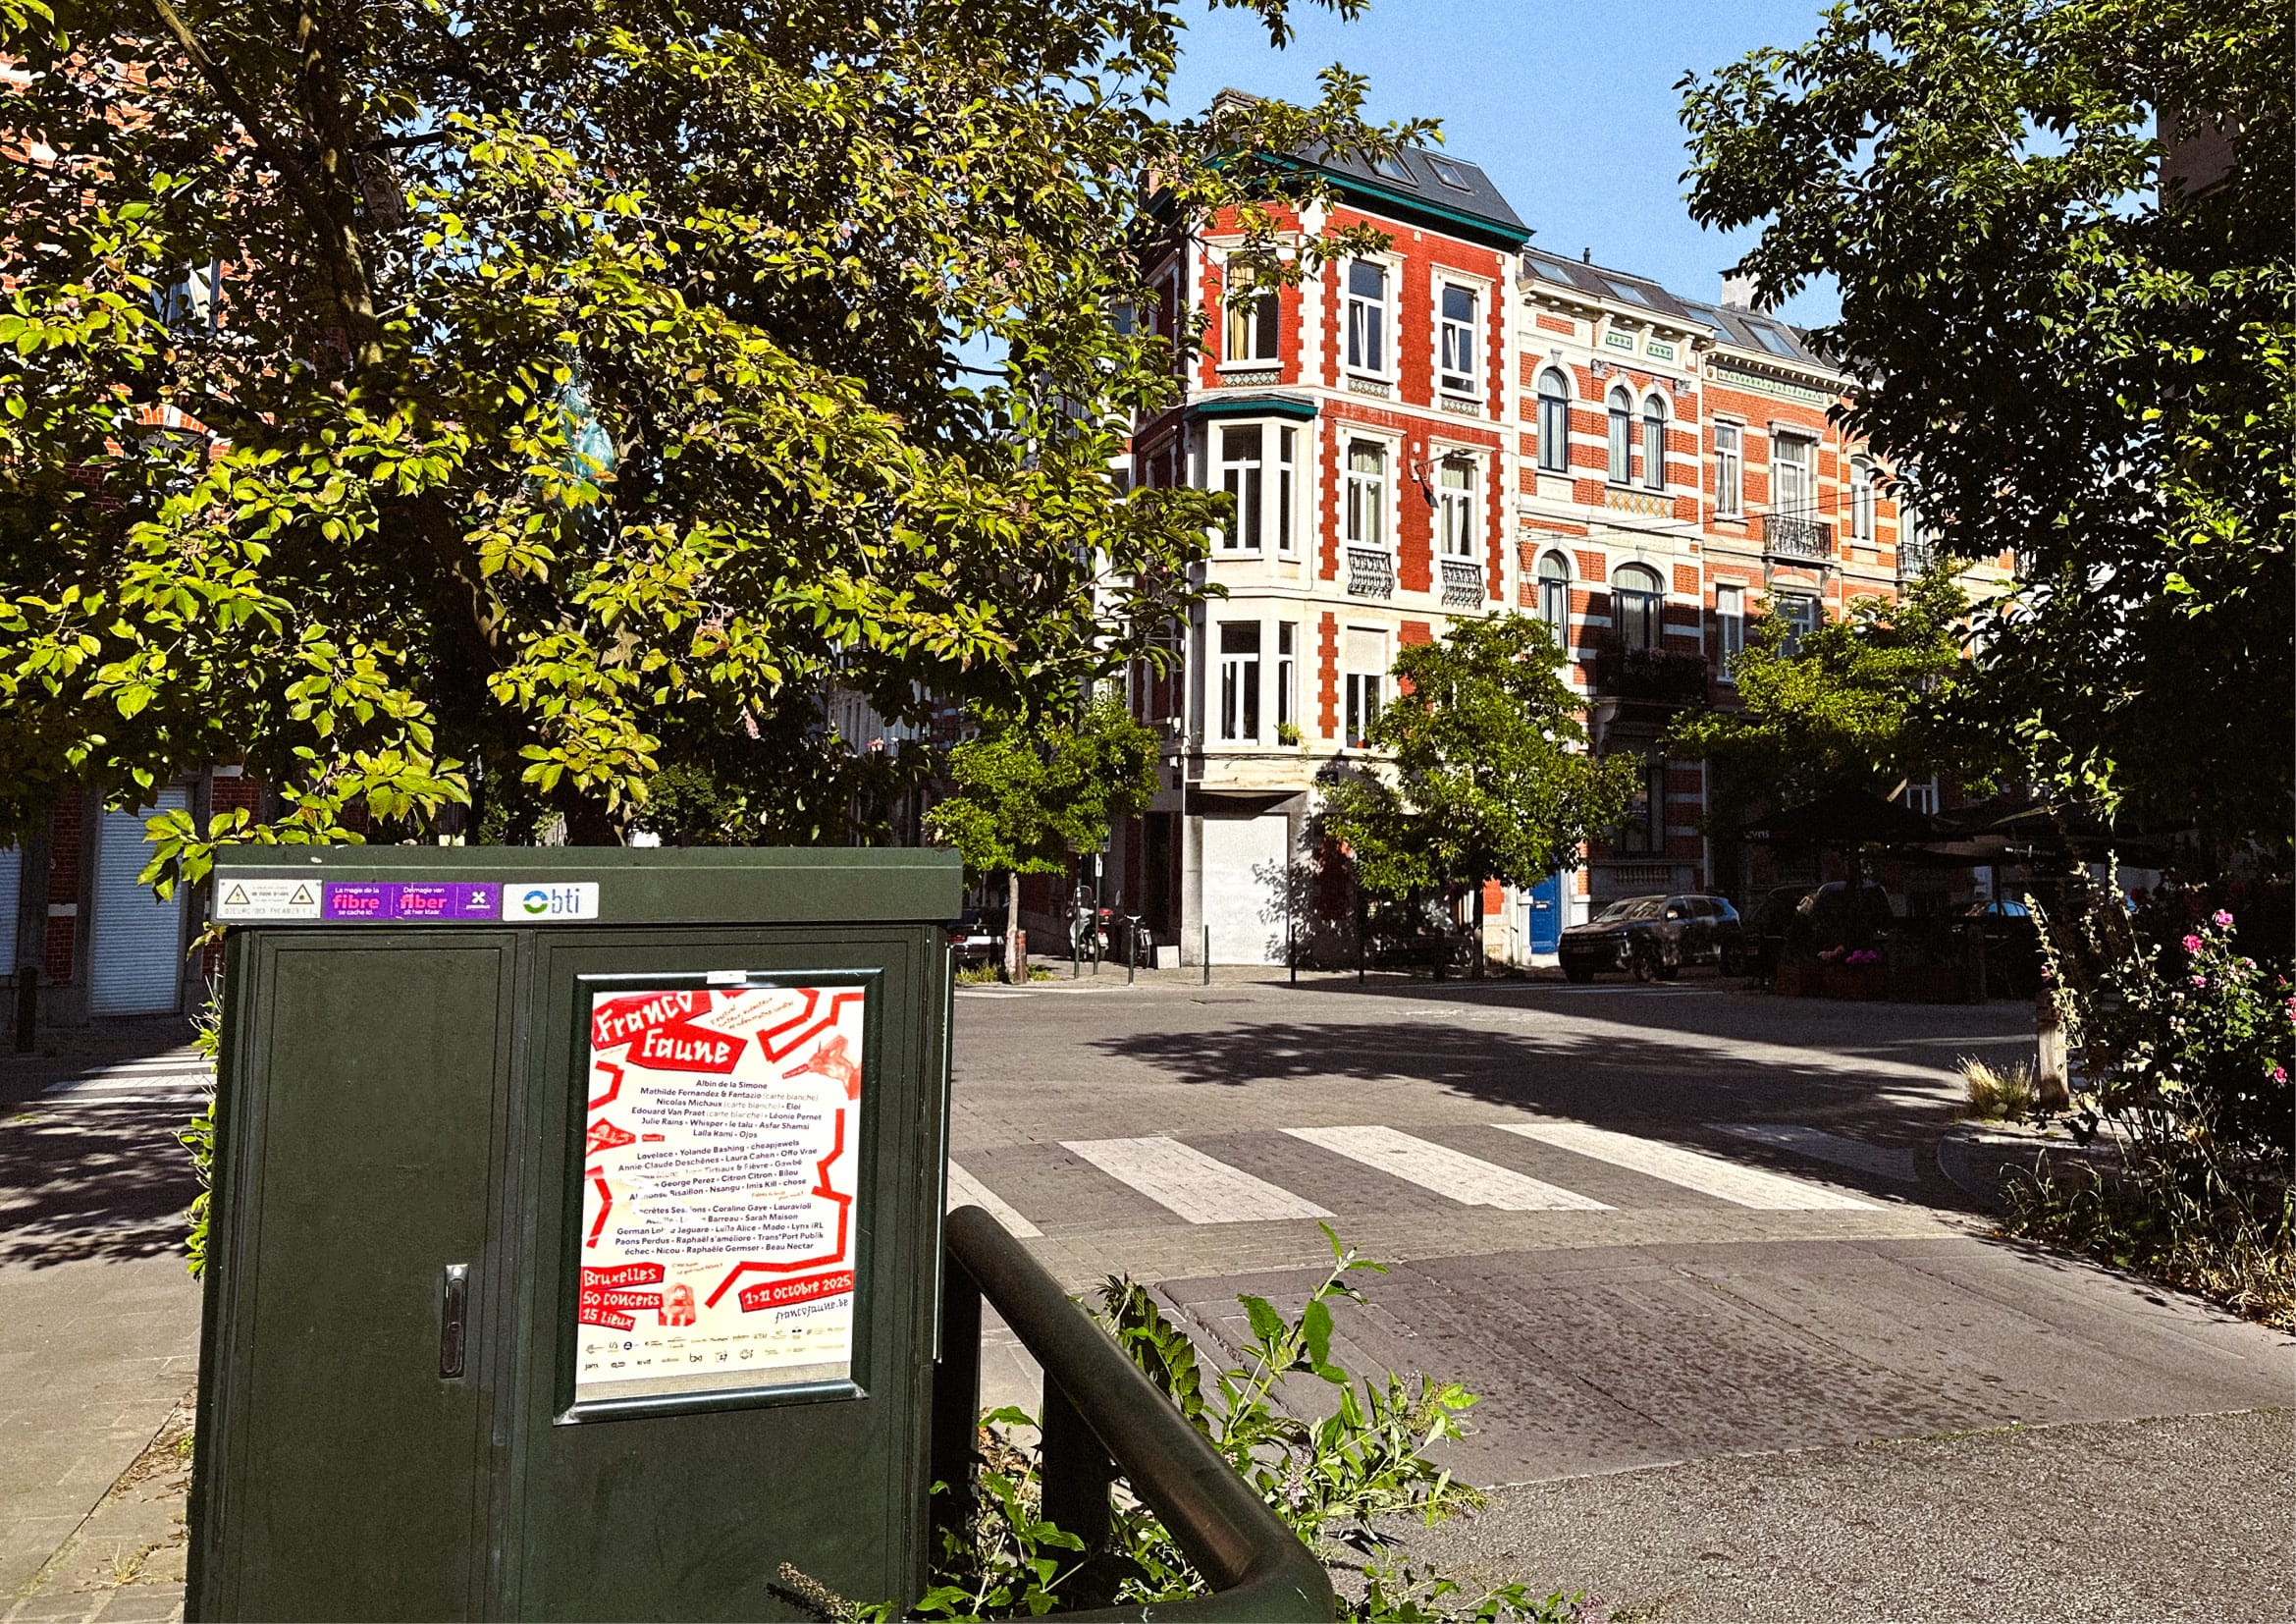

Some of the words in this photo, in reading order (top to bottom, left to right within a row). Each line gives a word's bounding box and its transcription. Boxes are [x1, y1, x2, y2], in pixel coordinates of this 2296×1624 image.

[333, 894, 380, 909] fibre
[400, 893, 448, 909] fiber
[552, 889, 580, 913] bti
[596, 991, 693, 1043] Franco
[642, 1027, 730, 1063] Faune
[640, 1087, 676, 1096] Mathilde
[677, 1089, 720, 1098] Fernandez
[656, 1098, 686, 1107] Nicolas
[688, 1099, 722, 1108] Michaux
[662, 1117, 683, 1126] Rains
[690, 1119, 723, 1128] Whisper
[739, 1130, 758, 1139] Ojos
[636, 1152, 673, 1161] Lovelace
[713, 1145, 745, 1154] Bashing
[751, 1140, 800, 1151] cheapjewels
[675, 1157, 720, 1166] Deschênes
[725, 1154, 748, 1163] Laura
[749, 1152, 775, 1161] Cahen
[661, 1179, 691, 1188] George
[747, 1204, 768, 1213] Gaye
[791, 1222, 810, 1231] Lynx
[675, 1235, 709, 1245] Raphaël
[624, 1247, 650, 1256] échec
[584, 1268, 656, 1286] Bruxelles
[822, 1273, 852, 1291] 2025
[583, 1290, 601, 1305] 50
[583, 1308, 598, 1321] 15
[774, 1298, 849, 1325] francofaune.be
